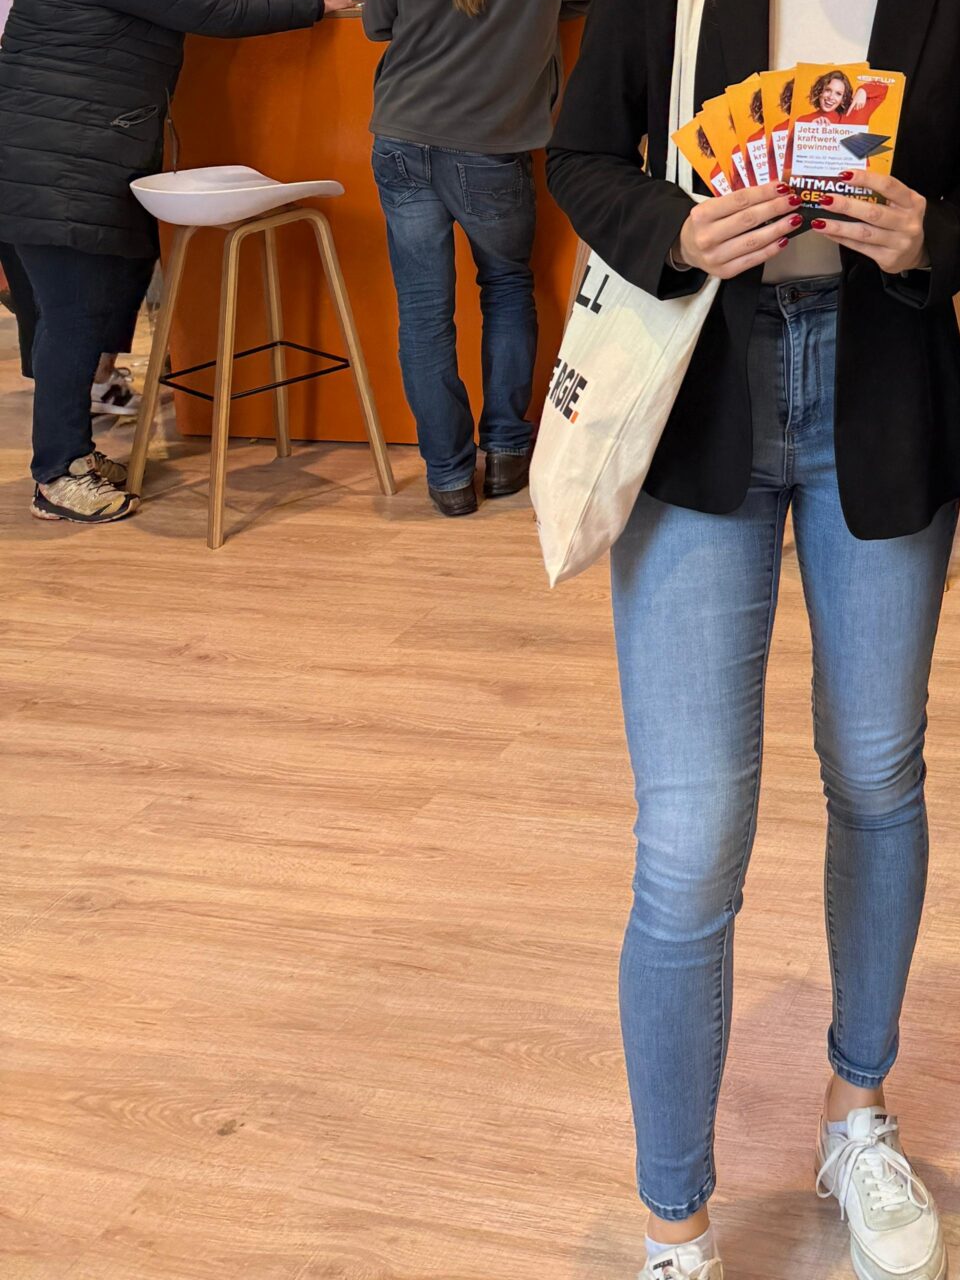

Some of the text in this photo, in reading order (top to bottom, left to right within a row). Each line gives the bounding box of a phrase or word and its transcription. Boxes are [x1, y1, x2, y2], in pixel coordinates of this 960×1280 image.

[797, 126, 854, 136] Jetzt Balkon-
[797, 134, 838, 144] kraftwerk
[796, 143, 840, 152] gewinnen!
[789, 176, 873, 195] MITMACHEN
